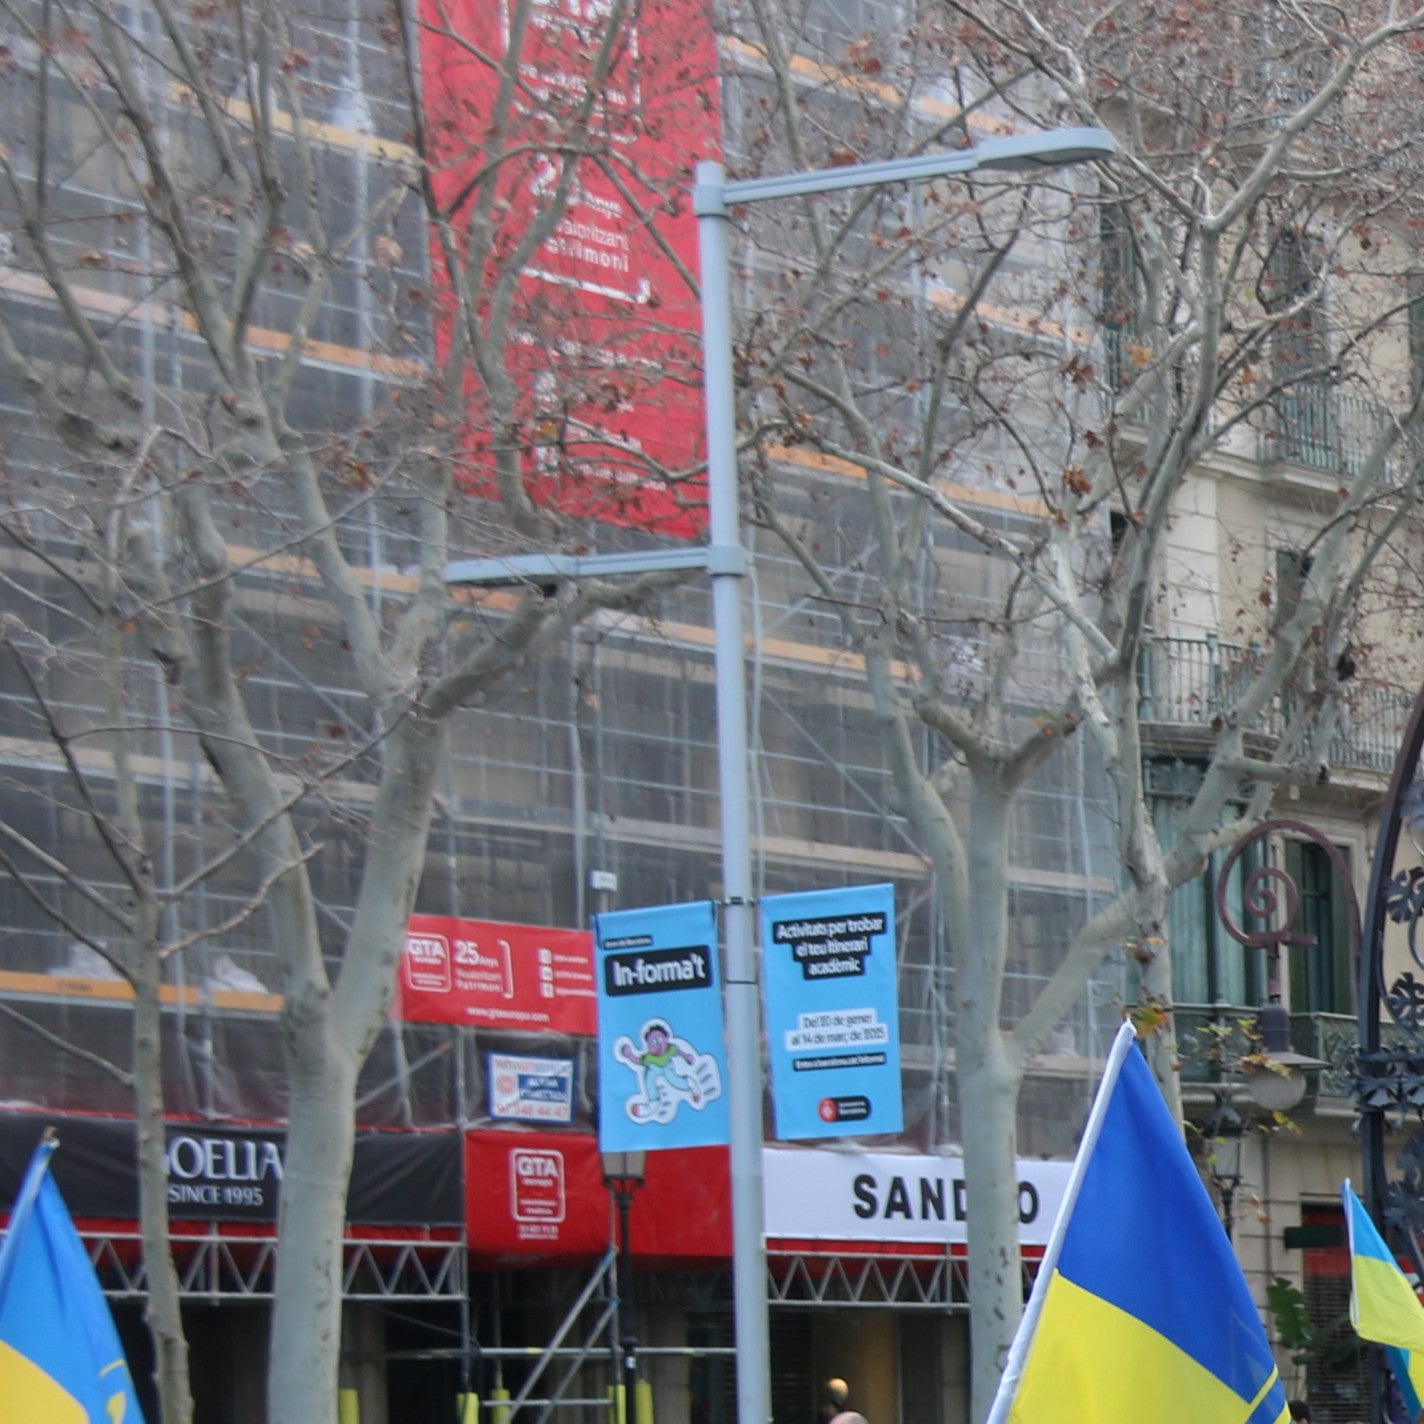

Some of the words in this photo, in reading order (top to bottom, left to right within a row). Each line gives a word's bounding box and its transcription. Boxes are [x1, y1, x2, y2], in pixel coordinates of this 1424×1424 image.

[543, 239, 629, 272] atrimoni
[777, 920, 827, 939] Activitats
[828, 920, 847, 937] per
[846, 916, 883, 933] trobar
[408, 938, 446, 958] GTA
[453, 939, 481, 965] 25
[809, 942, 827, 956] teu
[827, 936, 868, 954] itinerari
[612, 953, 705, 987] In-forma't
[803, 1016, 820, 1028] Del
[833, 1016, 845, 1027] de
[846, 1014, 873, 1027] gener
[163, 1135, 283, 1180] OELIA
[516, 1155, 560, 1178] GTA
[168, 1185, 221, 1204] SINCE
[223, 1187, 264, 1207] 1995
[853, 1174, 1040, 1225] SANDO
